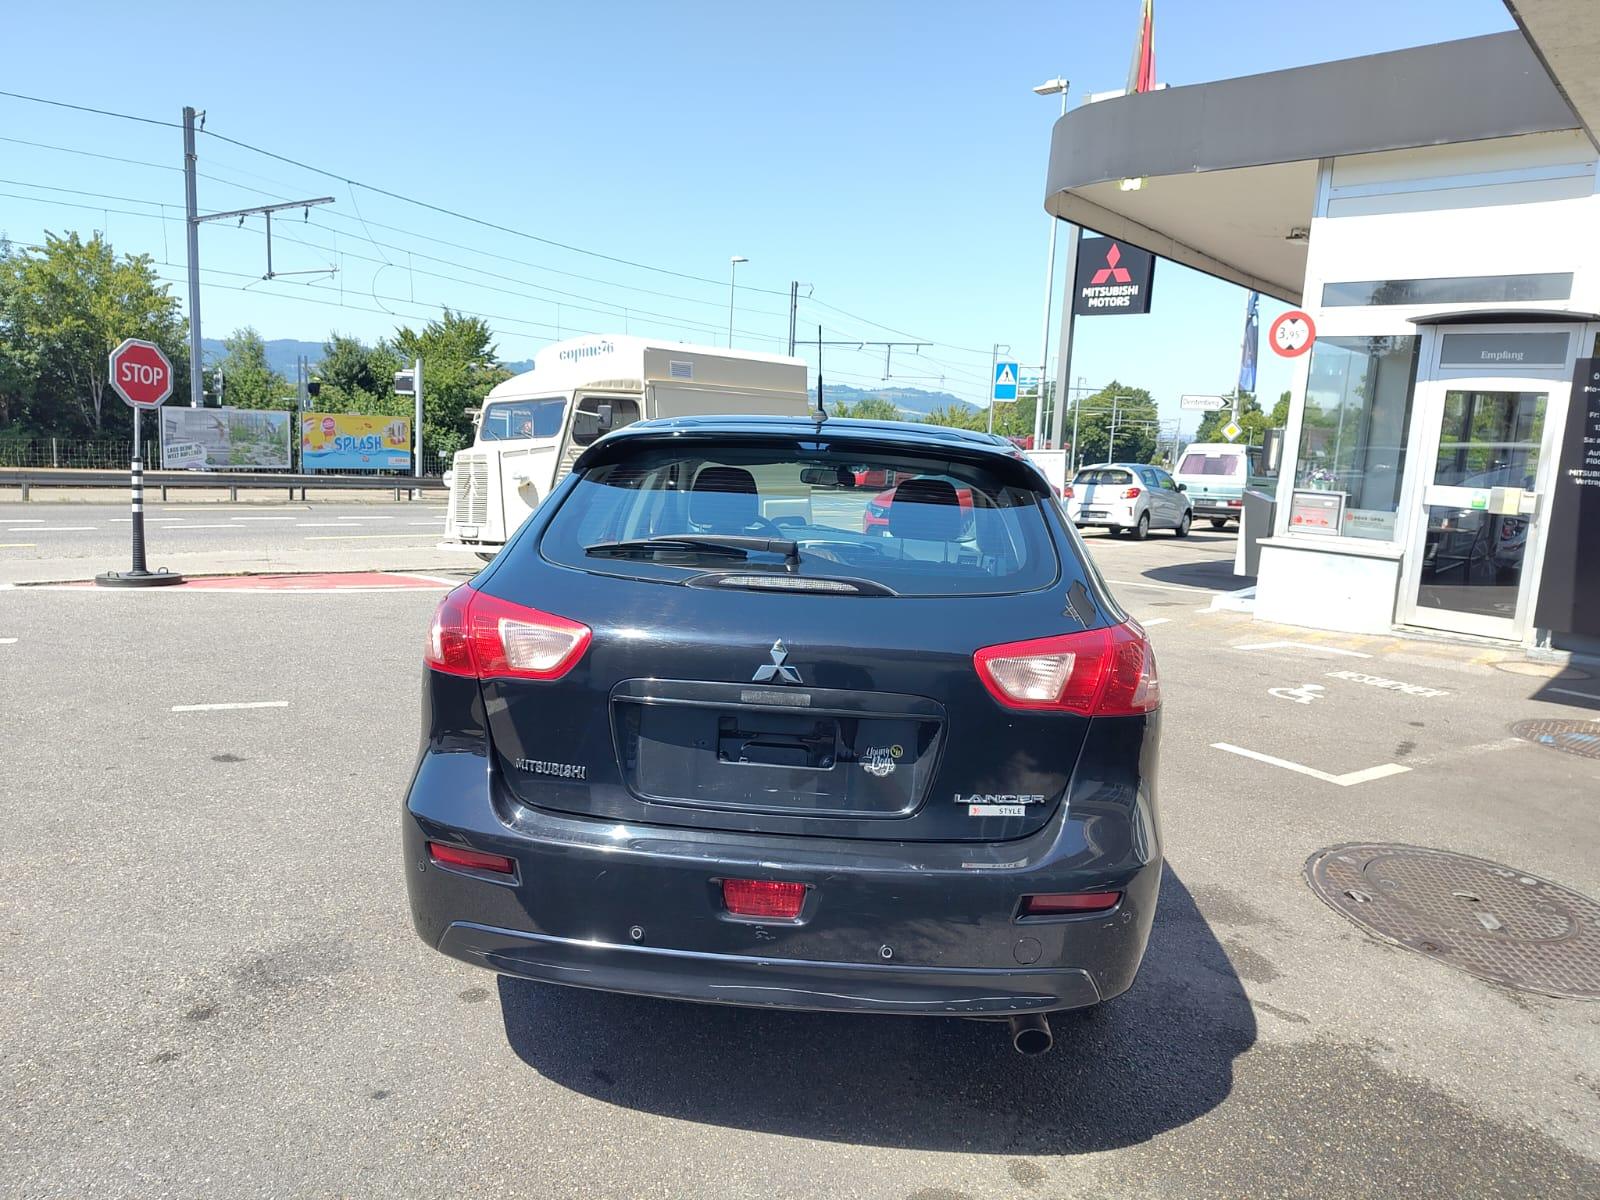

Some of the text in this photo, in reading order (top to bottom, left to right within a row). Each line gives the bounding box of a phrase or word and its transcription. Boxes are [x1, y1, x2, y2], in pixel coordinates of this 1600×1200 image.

[1082, 285, 1139, 298] MITSUBISHI
[1088, 296, 1130, 308] MOTORS
[1480, 350, 1524, 361] Empfang
[122, 362, 164, 386] STOP
[334, 435, 382, 451] SPLASH
[515, 758, 586, 779] MITSUBISHI
[954, 793, 1046, 804] LANCER
[999, 807, 1022, 815] STYLE
